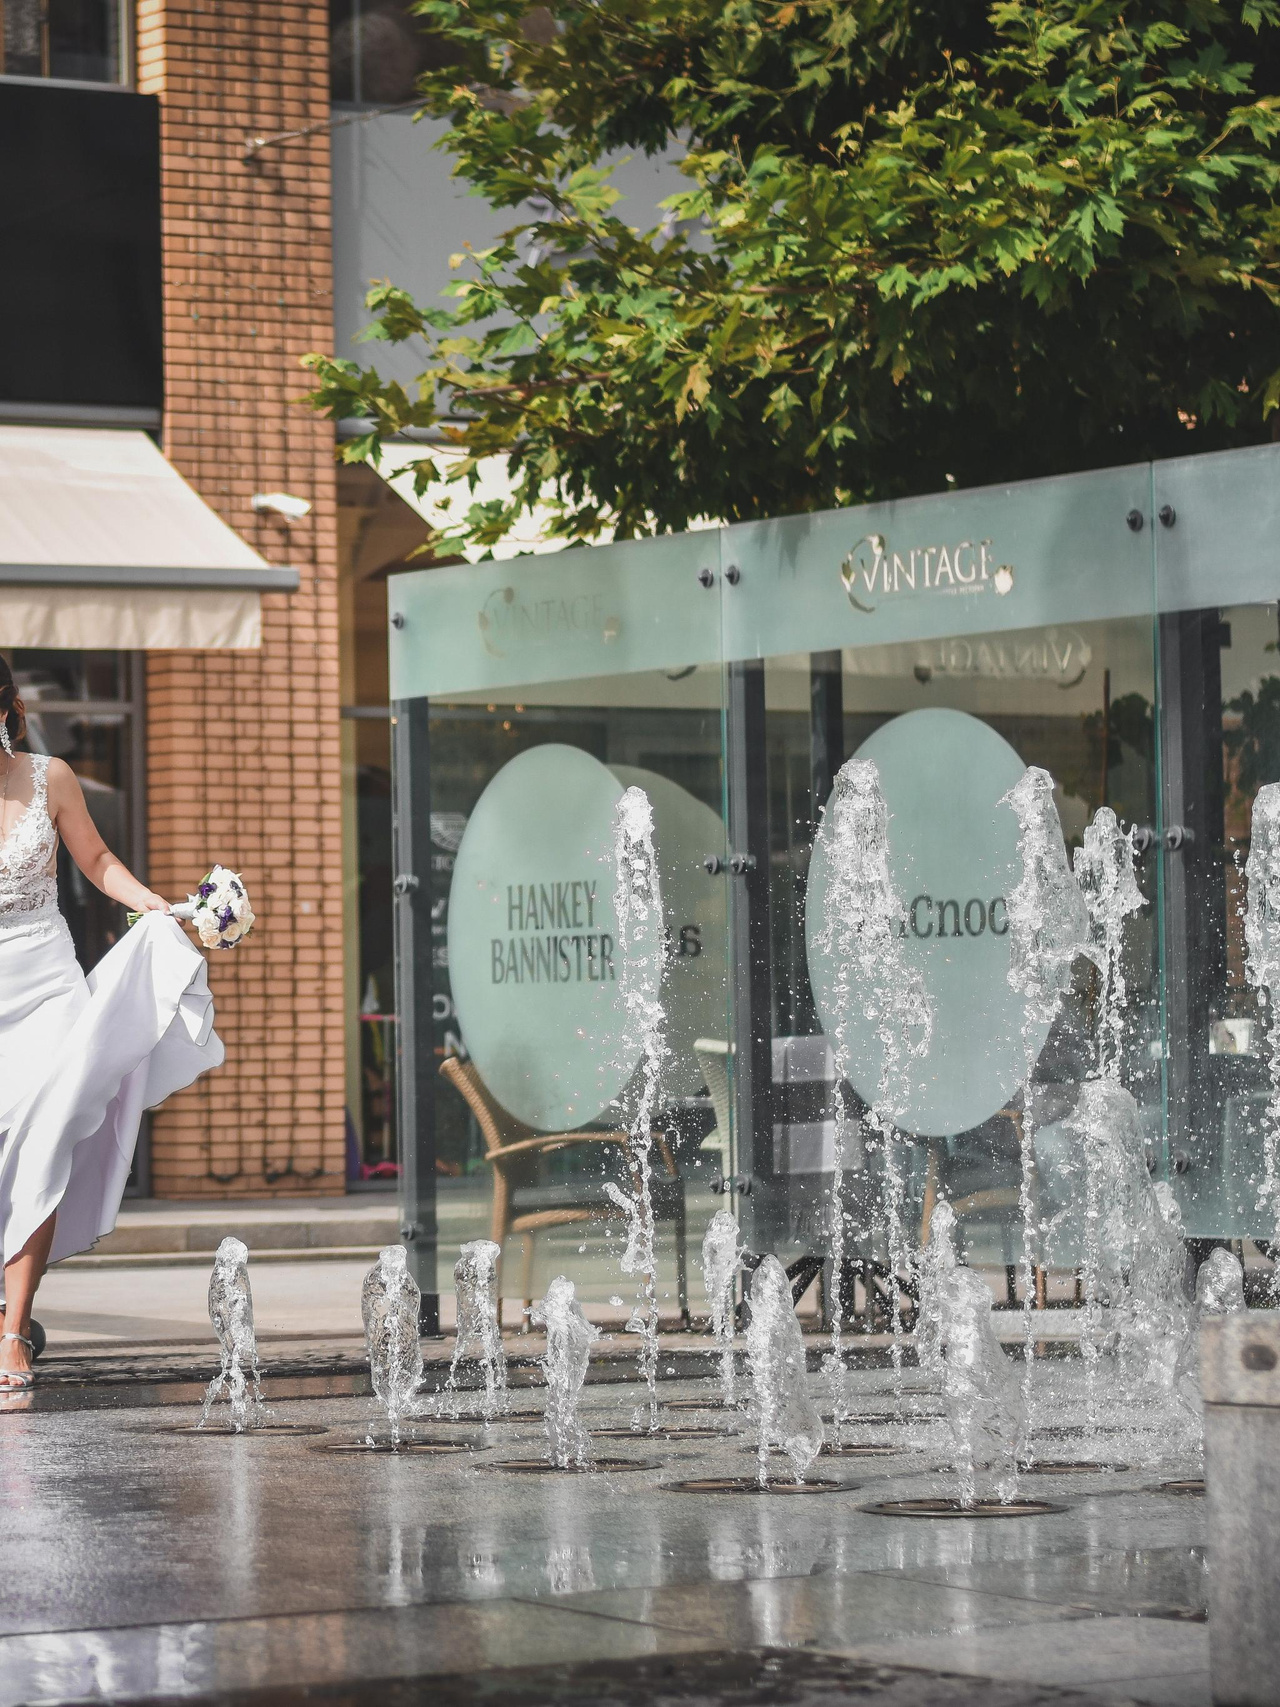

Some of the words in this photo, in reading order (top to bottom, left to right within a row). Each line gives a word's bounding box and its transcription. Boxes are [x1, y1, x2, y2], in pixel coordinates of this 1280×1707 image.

[860, 540, 992, 593] VINTAGE
[506, 879, 597, 931] HANKEY
[884, 894, 1010, 940] Cnoc
[490, 933, 616, 984] BANNISTER
